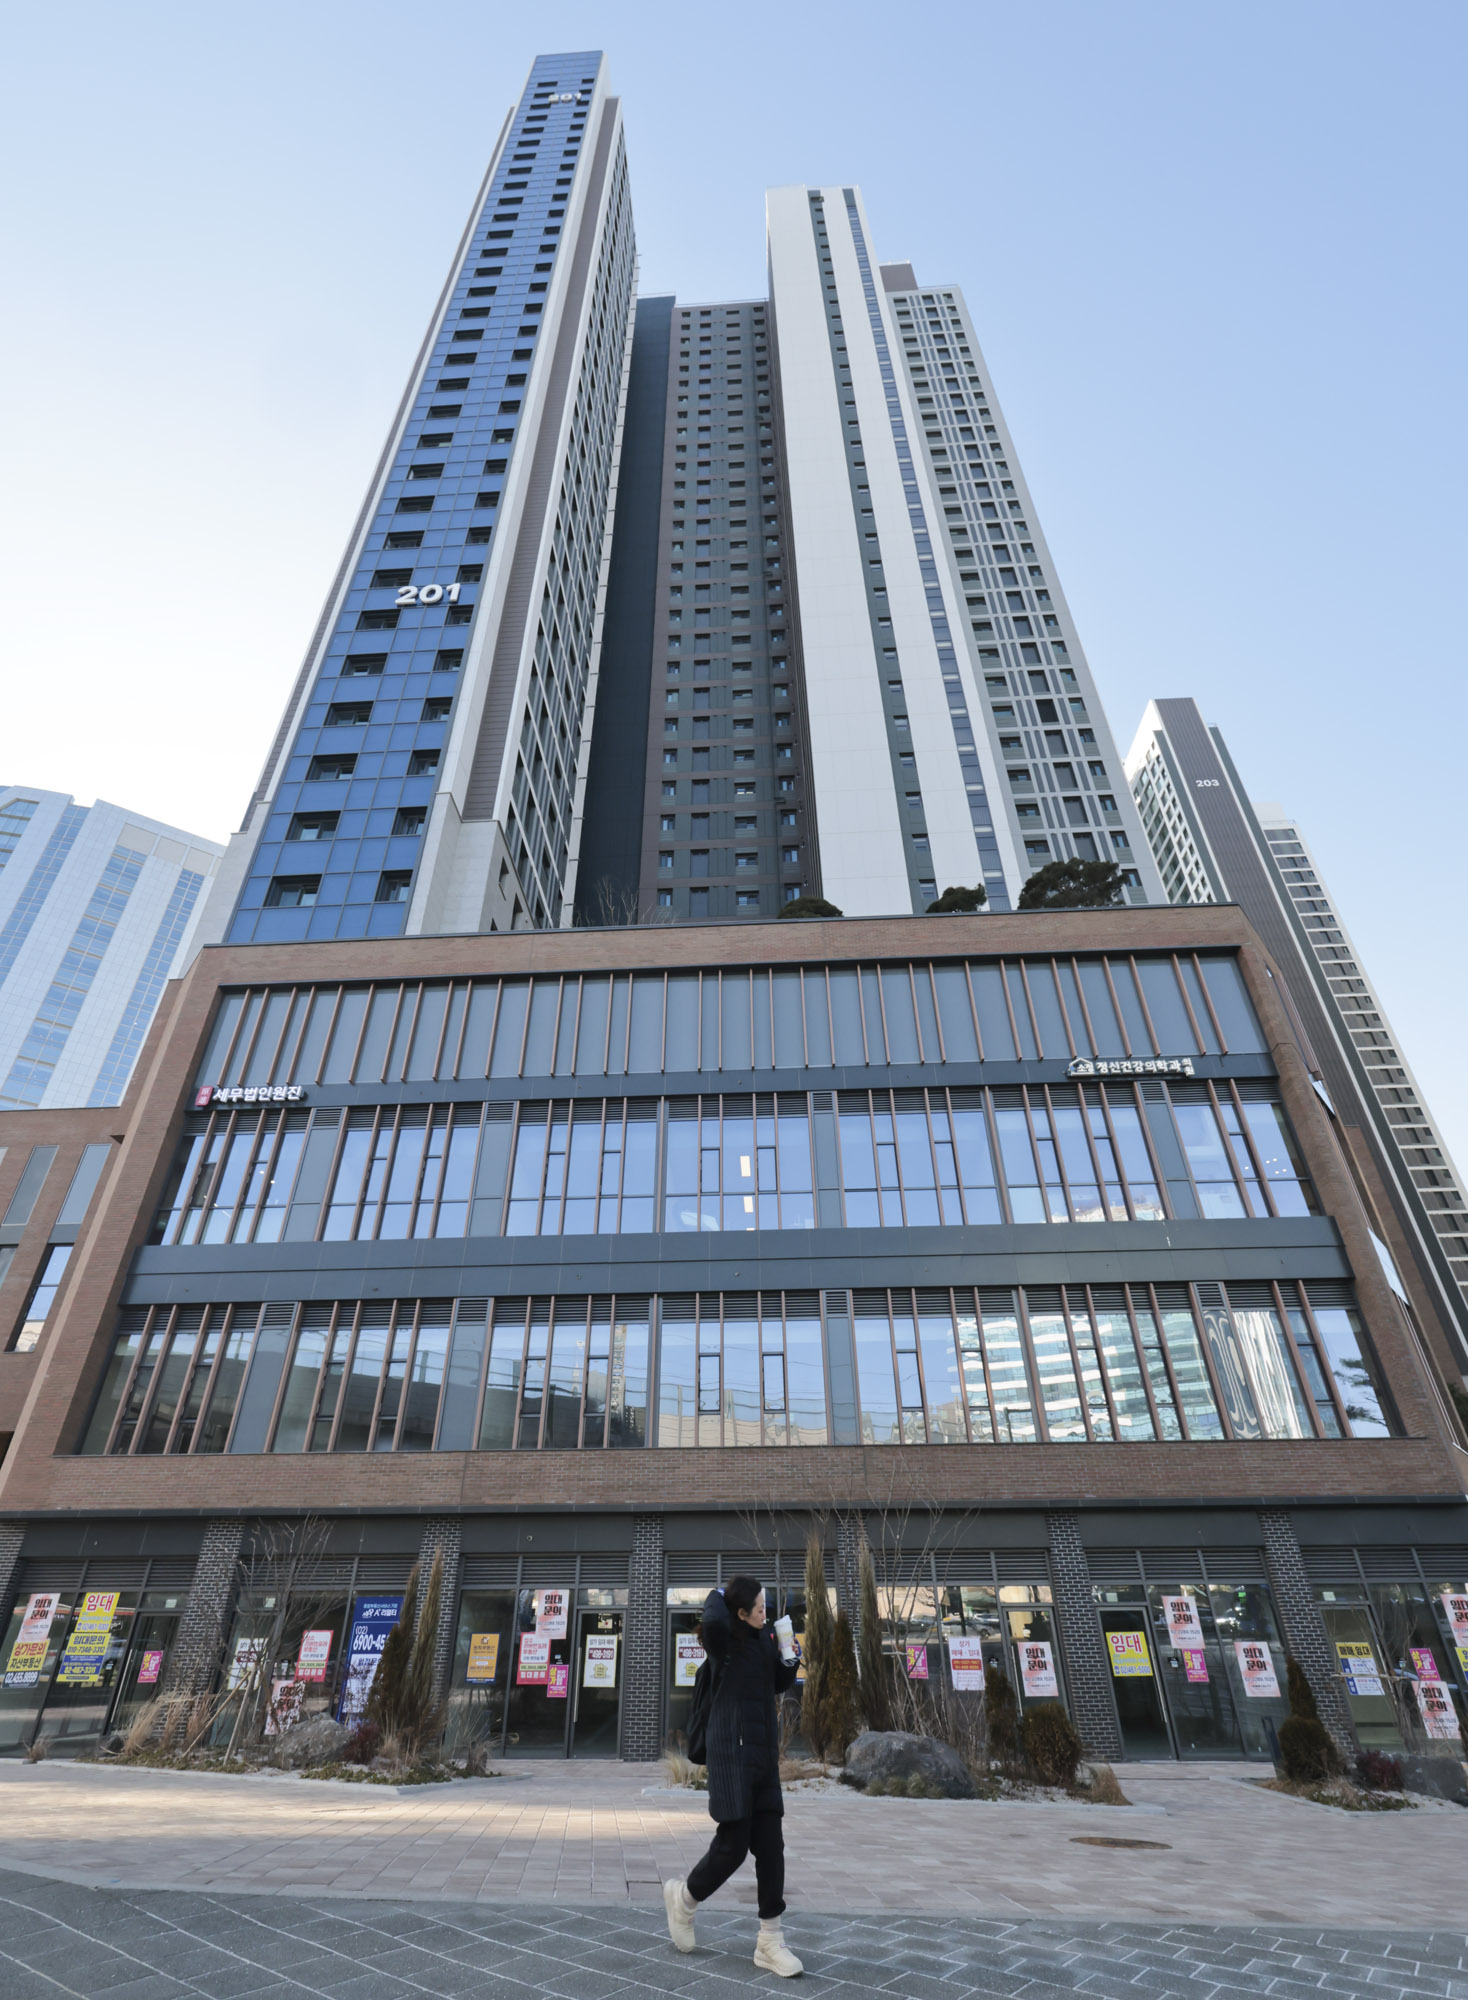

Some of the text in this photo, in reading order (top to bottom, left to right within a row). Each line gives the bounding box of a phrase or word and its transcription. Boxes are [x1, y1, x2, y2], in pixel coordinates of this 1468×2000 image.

[395, 583, 460, 605] 201
[1195, 779, 1220, 787] 203
[1096, 1060, 1181, 1073] 정신건강의학과
[213, 1086, 304, 1103] 세무법인원진
[34, 1599, 52, 1608] 임대
[87, 1594, 115, 1612] 임대
[544, 1595, 563, 1604] 임대
[544, 1605, 562, 1616] 문의
[1170, 1601, 1190, 1612] 임대
[1173, 1613, 1193, 1624] 문의
[355, 1625, 368, 1635] (02)
[74, 1636, 105, 1645] 임대문의
[353, 1634, 390, 1651] 6900-45
[959, 1640, 970, 1648] 상가
[1110, 1634, 1142, 1653] 임대
[14, 1643, 46, 1656] 상가문의
[1026, 1648, 1046, 1659] 임대
[1243, 1648, 1264, 1658] 임대
[1028, 1660, 1048, 1671] 문의
[1246, 1660, 1267, 1671] 문의
[1422, 1688, 1444, 1699] 임대
[1426, 1701, 1447, 1712] 문의
